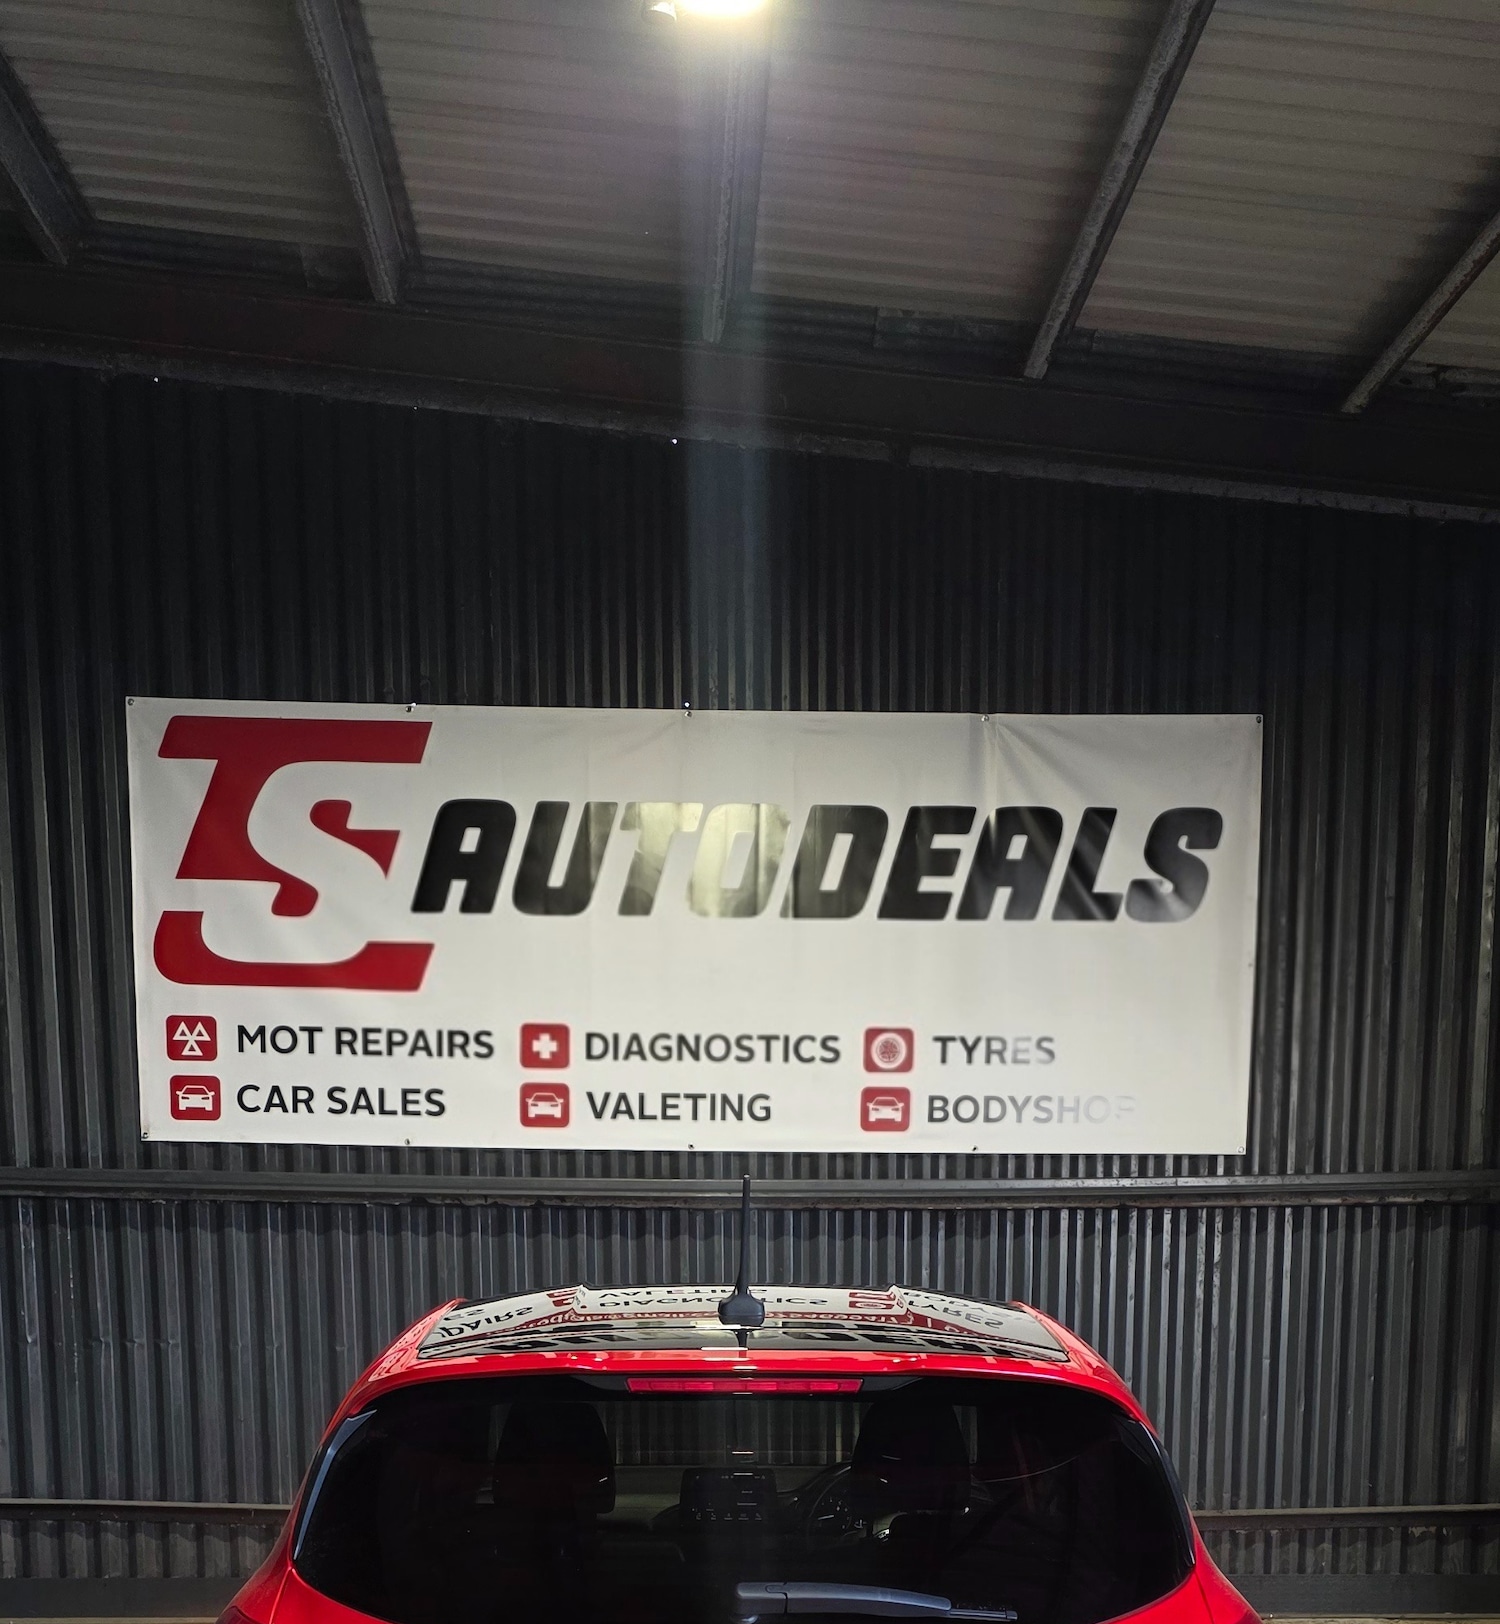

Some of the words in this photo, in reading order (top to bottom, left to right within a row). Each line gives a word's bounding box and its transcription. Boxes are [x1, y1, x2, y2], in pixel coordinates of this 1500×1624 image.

[153, 715, 435, 992] TS
[411, 798, 1223, 923] AUTODEALS
[237, 1025, 323, 1054] MOT
[335, 1026, 495, 1059] REPAIRS
[585, 1032, 841, 1064] DIAGNOSTICS
[932, 1035, 1056, 1065] TYRES
[237, 1084, 315, 1114] CAR
[327, 1086, 446, 1117] SALES
[586, 1091, 772, 1122] VALETING
